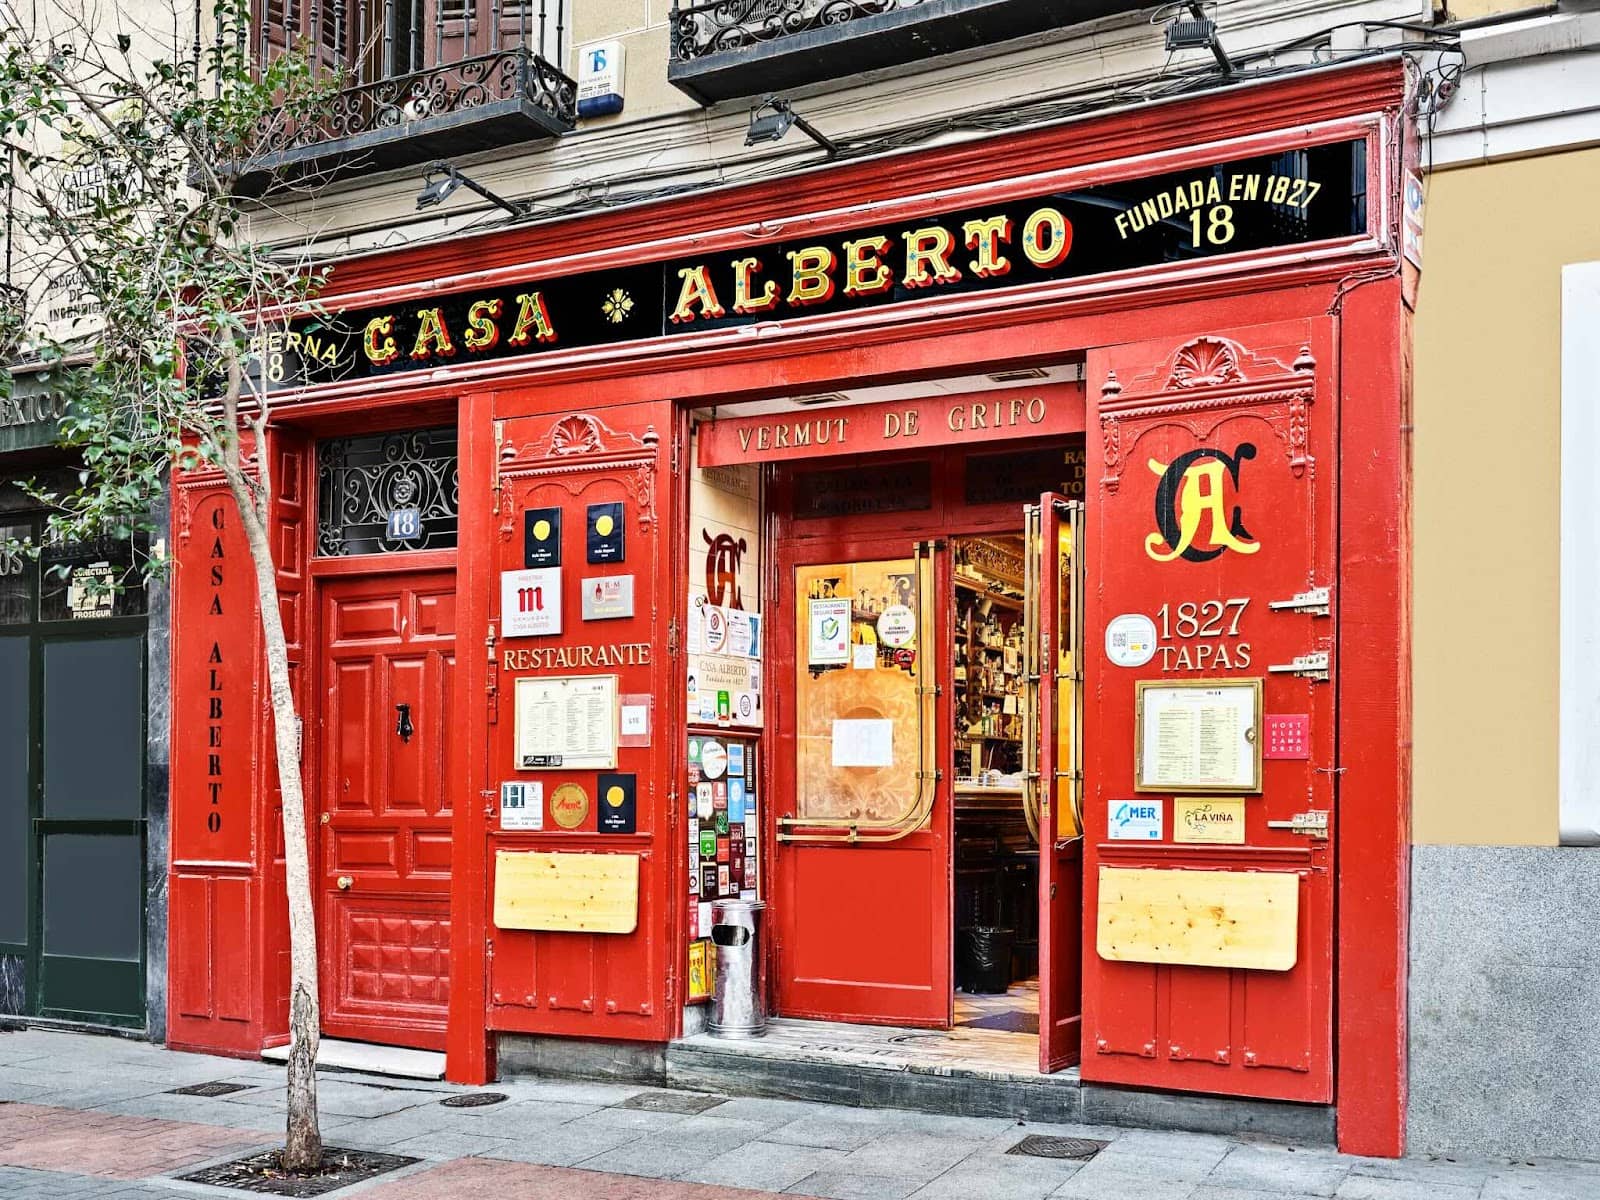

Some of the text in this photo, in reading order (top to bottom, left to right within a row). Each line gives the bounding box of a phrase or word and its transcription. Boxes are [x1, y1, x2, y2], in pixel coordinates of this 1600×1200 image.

[1114, 174, 1321, 240] FUNDADA EN 1827
[1189, 204, 1236, 248] 18
[363, 207, 1074, 367] CASA ALBERTO
[738, 398, 1047, 453] VERMUT DE GRIFO
[1064, 450, 1085, 465] RA
[1061, 481, 1084, 495] TO
[393, 512, 415, 536] 18
[73, 609, 112, 619] PROSEGUR
[1157, 598, 1250, 640] 1827
[207, 508, 225, 833] CASA ALBERTO
[503, 643, 651, 671] RESTAURANTE
[719, 664, 747, 676] ALBERTO
[1157, 644, 1251, 671] TAPAS
[1195, 811, 1233, 823] LA VIÑA
